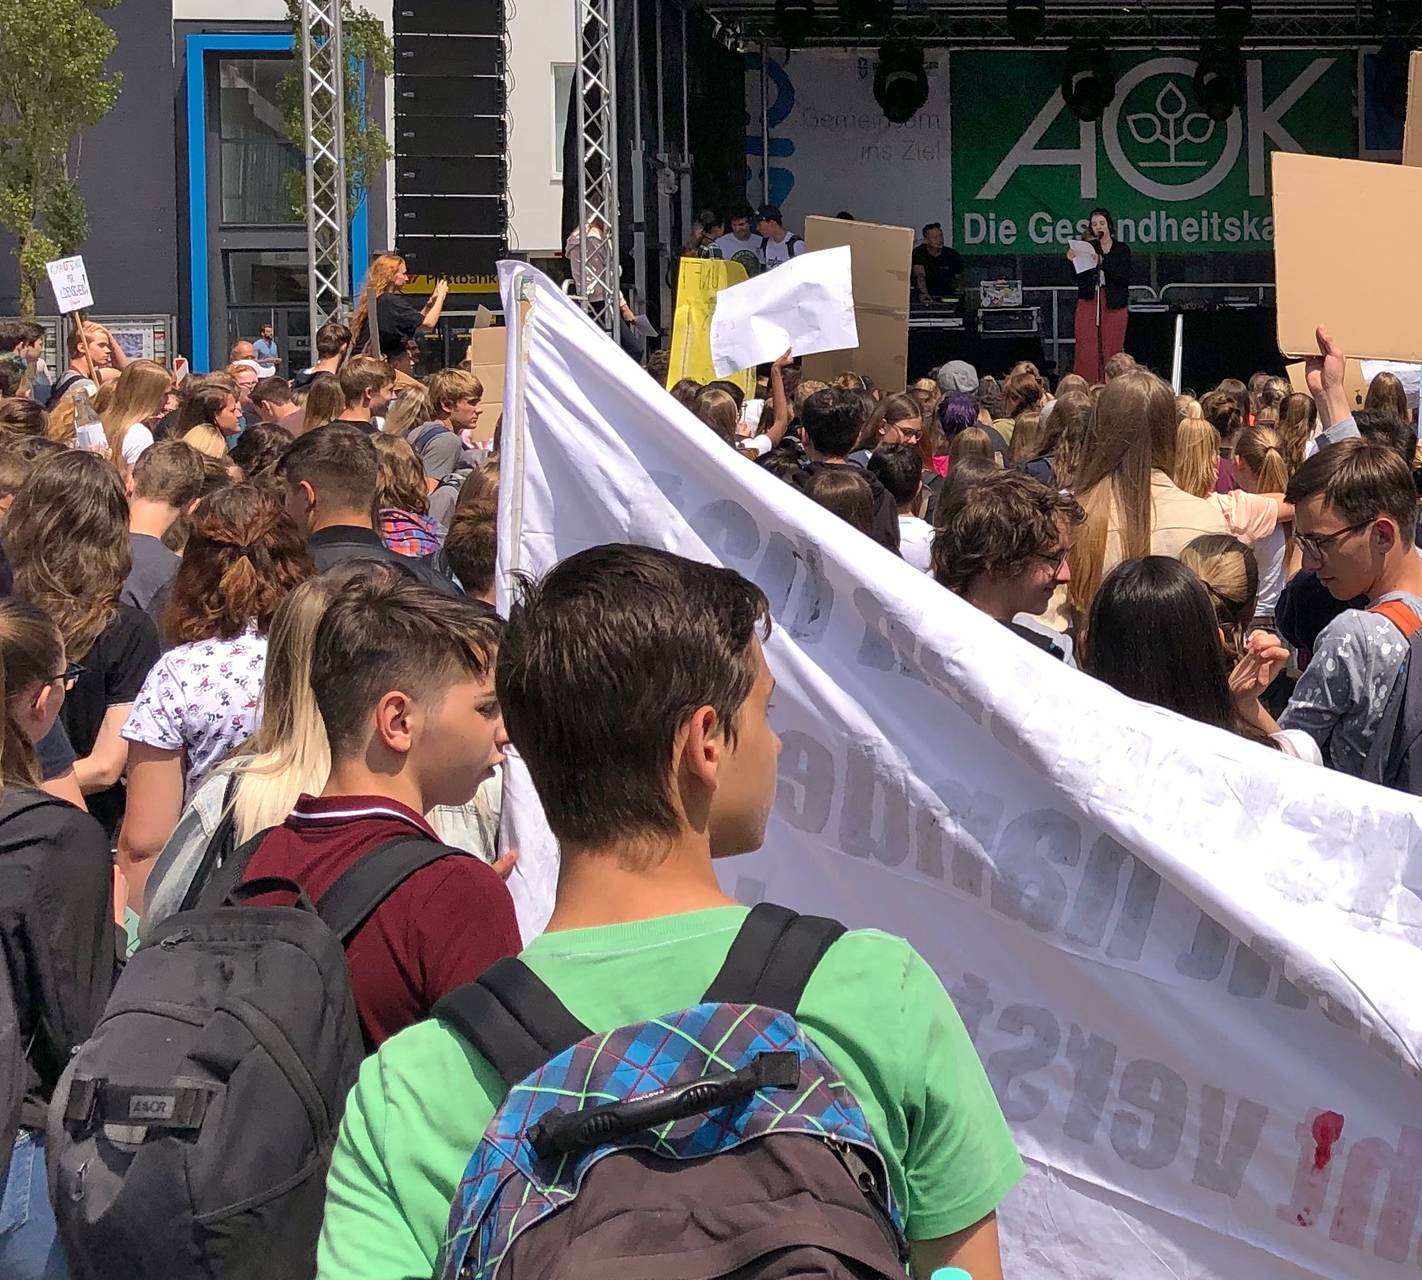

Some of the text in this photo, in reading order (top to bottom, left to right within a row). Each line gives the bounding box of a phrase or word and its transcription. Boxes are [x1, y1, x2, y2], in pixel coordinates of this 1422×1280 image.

[803, 105, 940, 129] Gemeinam
[976, 57, 1338, 201] AOK
[964, 210, 1274, 245] Die Gesndheitska
[426, 272, 497, 286] Pstbank
